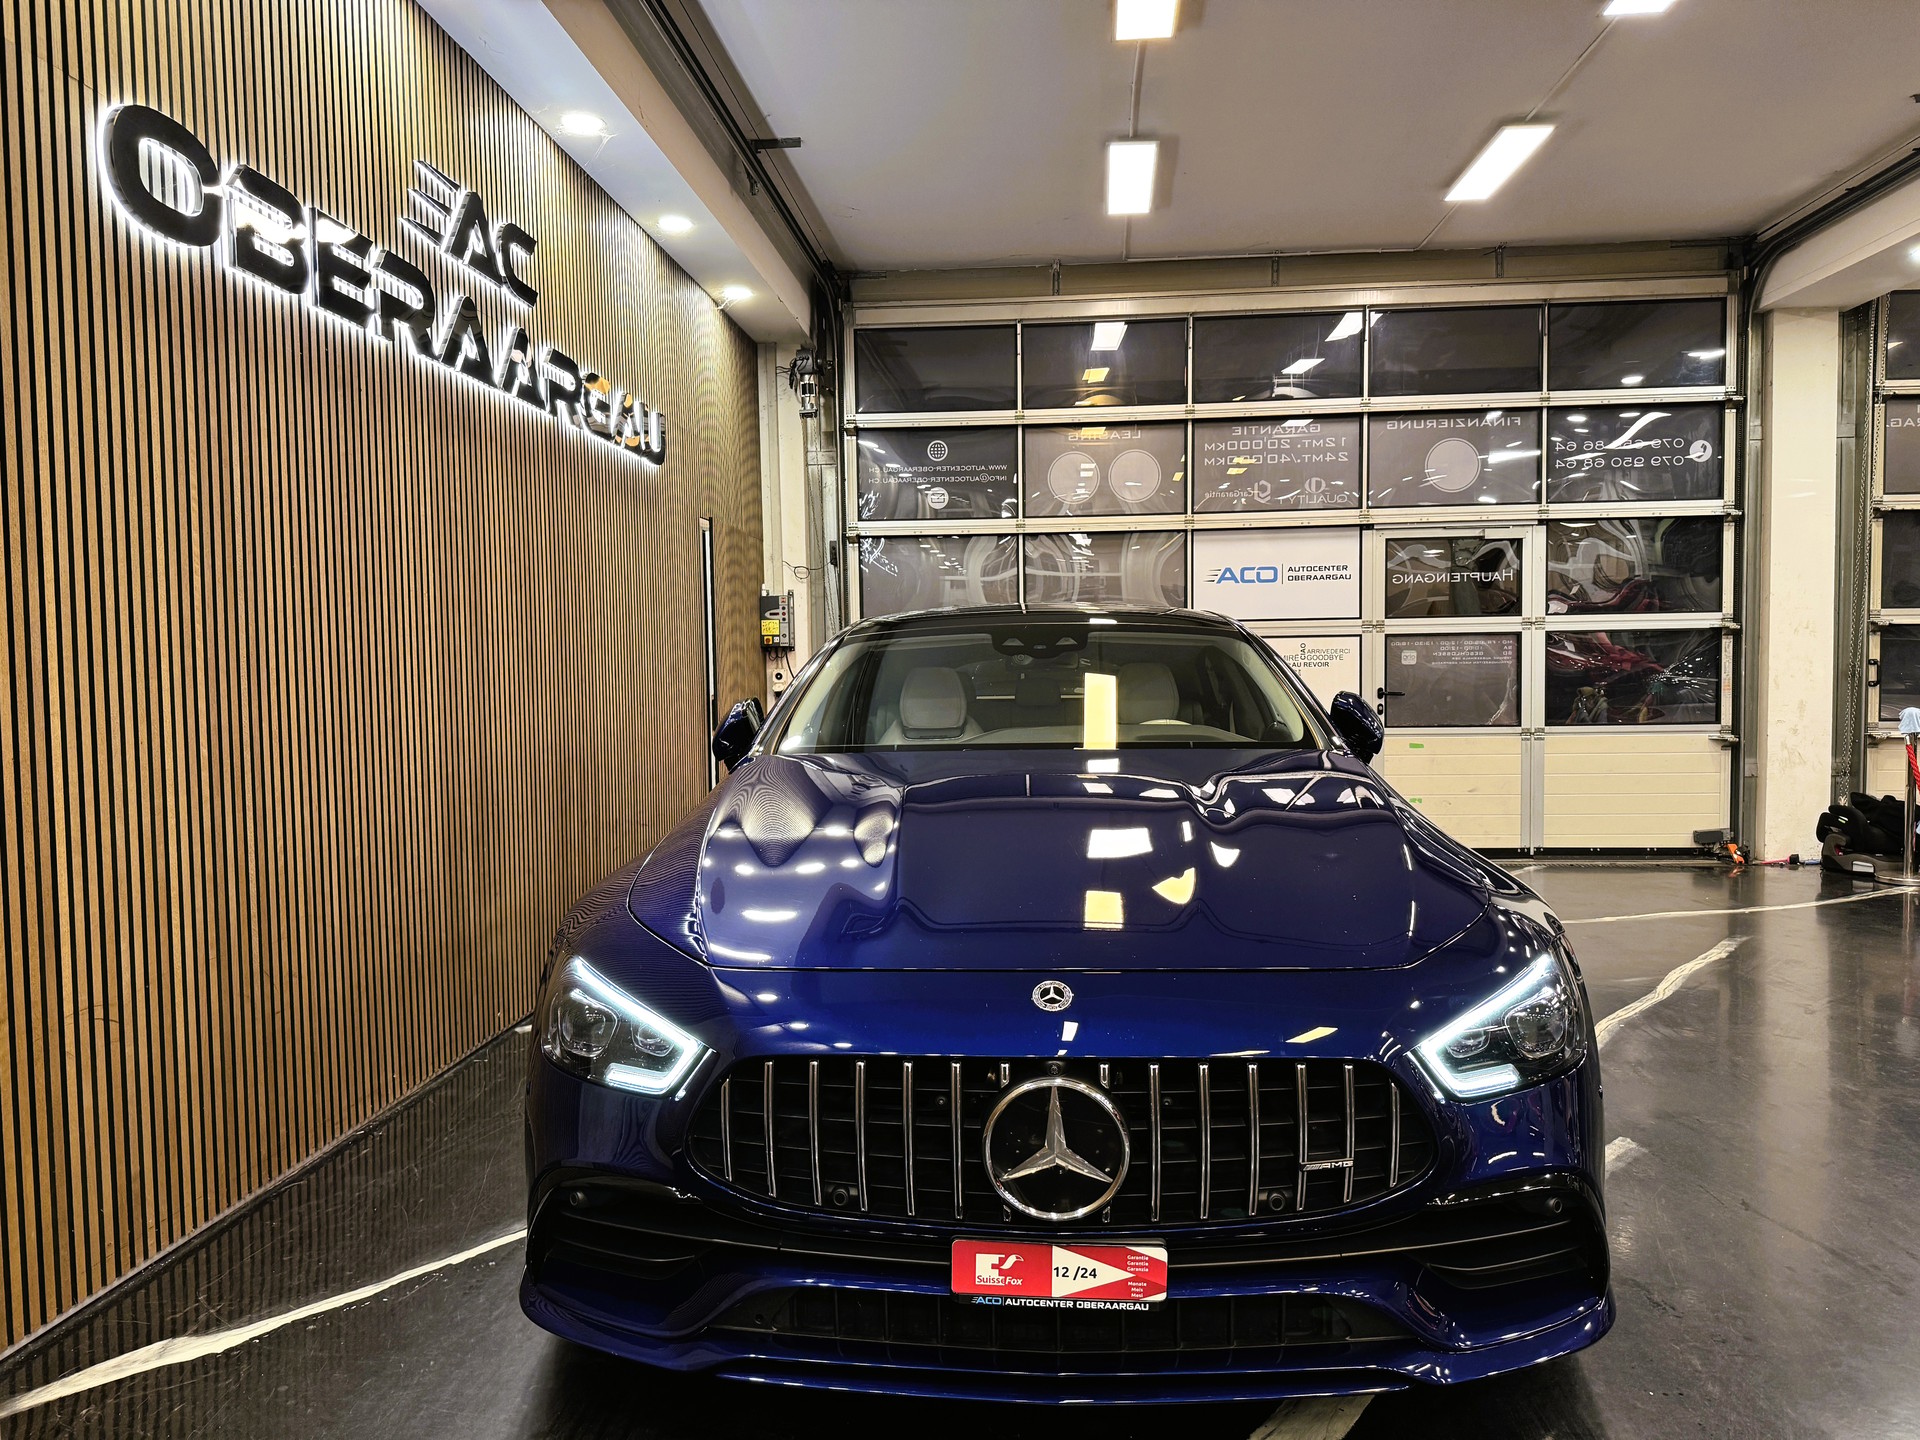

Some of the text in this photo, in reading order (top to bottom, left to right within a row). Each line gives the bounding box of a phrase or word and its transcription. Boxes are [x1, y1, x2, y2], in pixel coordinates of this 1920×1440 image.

[441, 190, 538, 308] AC
[103, 103, 666, 466] OBERAARGAU
[1216, 566, 1279, 584] ACO
[1287, 564, 1348, 573] AUTOCENTER
[1287, 573, 1352, 582] OBERAARGAU
[1320, 1160, 1354, 1169] AMG
[1053, 1265, 1098, 1281] 12 /24
[975, 1296, 1150, 1311] ACO AUTOCENTER OBERAARGAU
